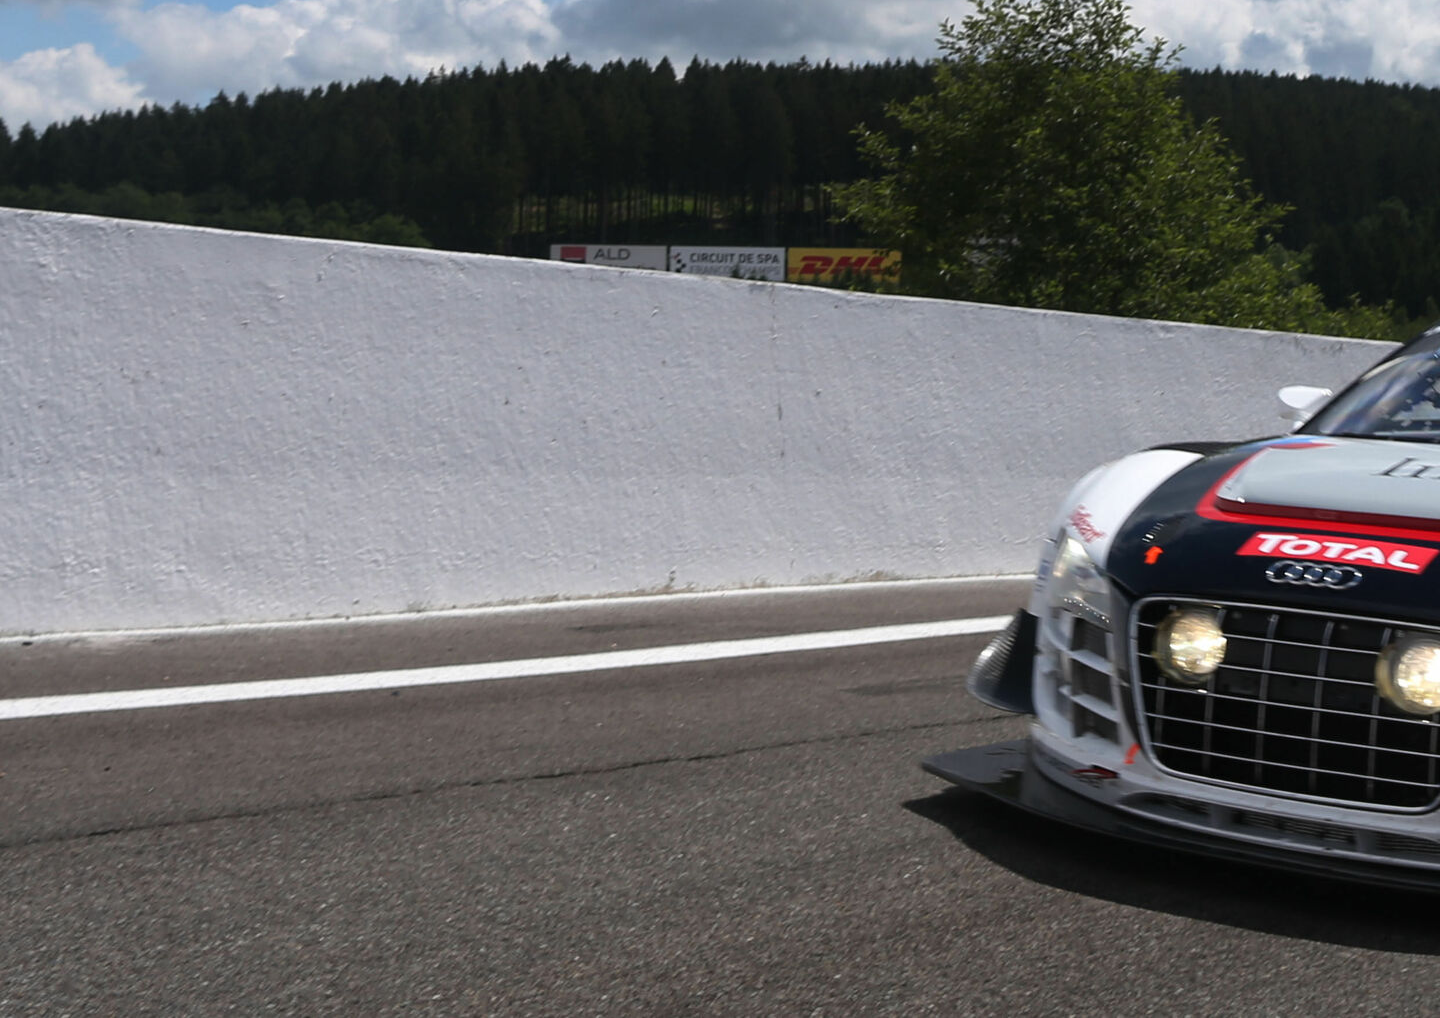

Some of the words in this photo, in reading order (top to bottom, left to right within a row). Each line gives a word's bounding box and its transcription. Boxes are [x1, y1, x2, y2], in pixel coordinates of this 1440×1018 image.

[593, 248, 631, 261] ALD
[689, 253, 735, 263] CIRCUIT
[738, 253, 755, 263] DE
[757, 254, 780, 264] SPA
[800, 255, 886, 275] DHL
[1255, 534, 1422, 570] TOTAL
